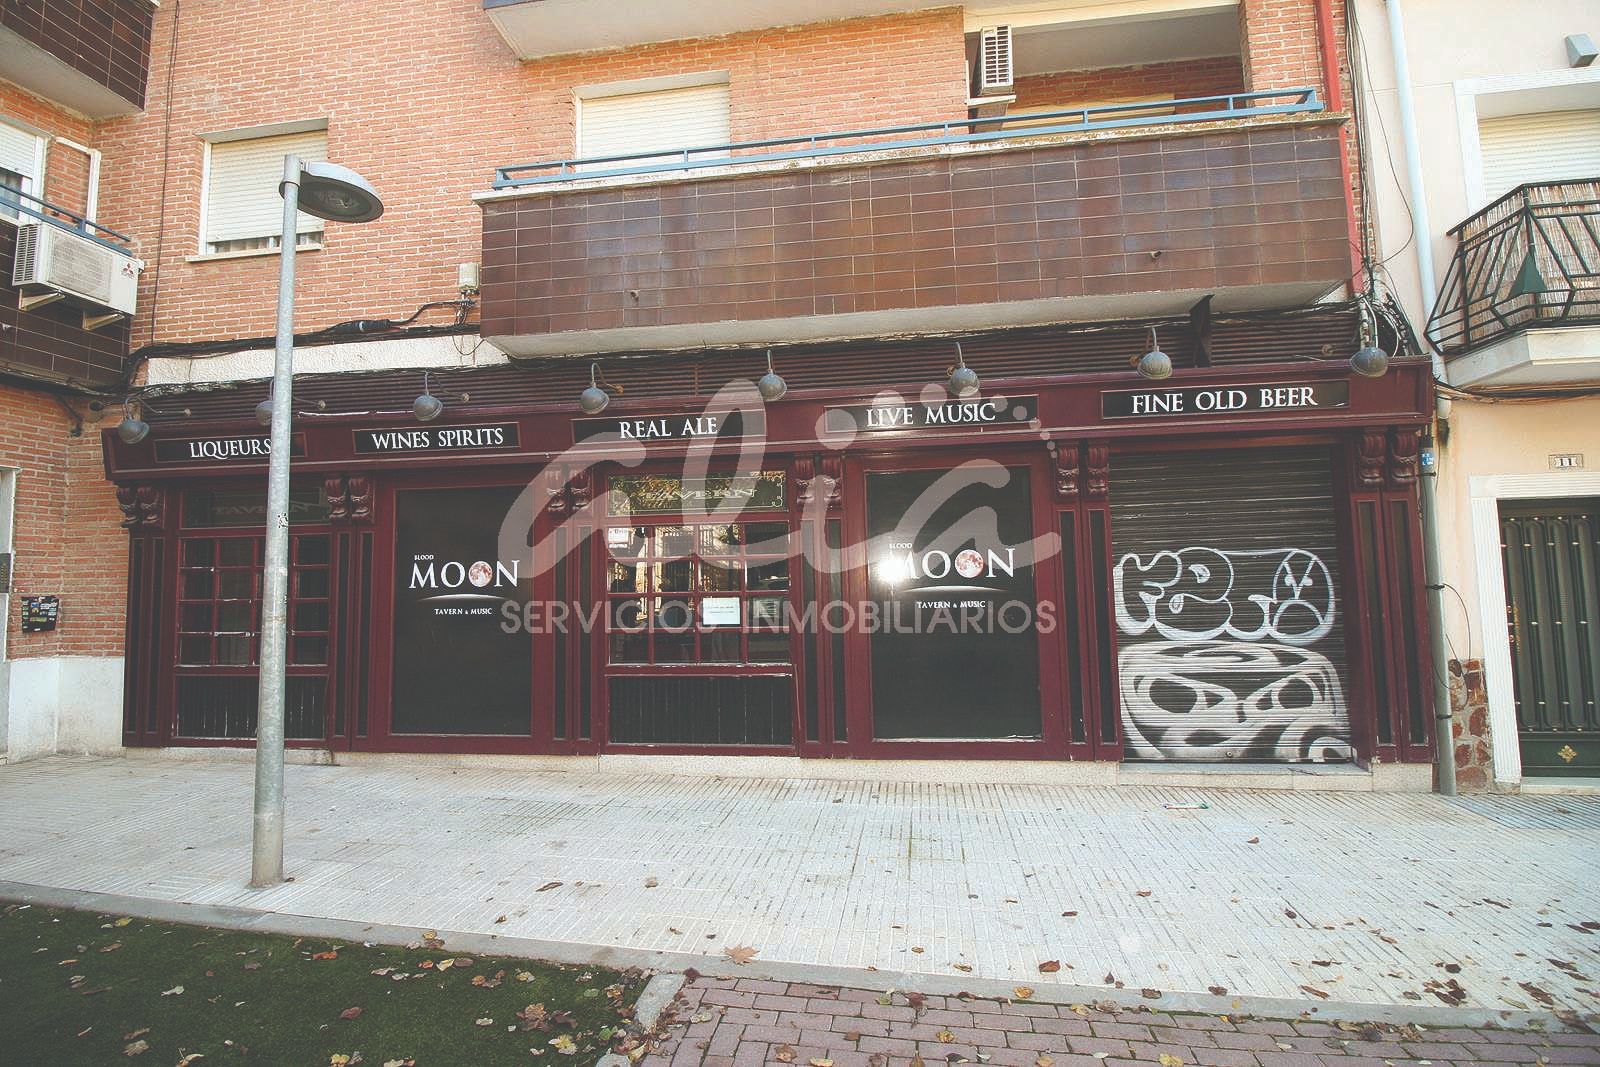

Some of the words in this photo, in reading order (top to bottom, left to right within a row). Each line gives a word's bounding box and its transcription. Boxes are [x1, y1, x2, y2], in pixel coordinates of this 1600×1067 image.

[1131, 393, 1183, 414] FINE
[1195, 391, 1247, 411] OLD
[1259, 386, 1318, 408] BEER
[866, 407, 914, 427] LIVE
[925, 402, 996, 424] MUSIC
[371, 430, 430, 449] WINES
[438, 427, 504, 447] SPIRITS
[619, 419, 671, 439] REAL
[681, 417, 718, 436] ALE
[189, 438, 272, 459] LIQUEURS
[408, 560, 520, 588] MOON
[470, 607, 493, 615] MUSIC
[916, 601, 951, 609] TAVERN
